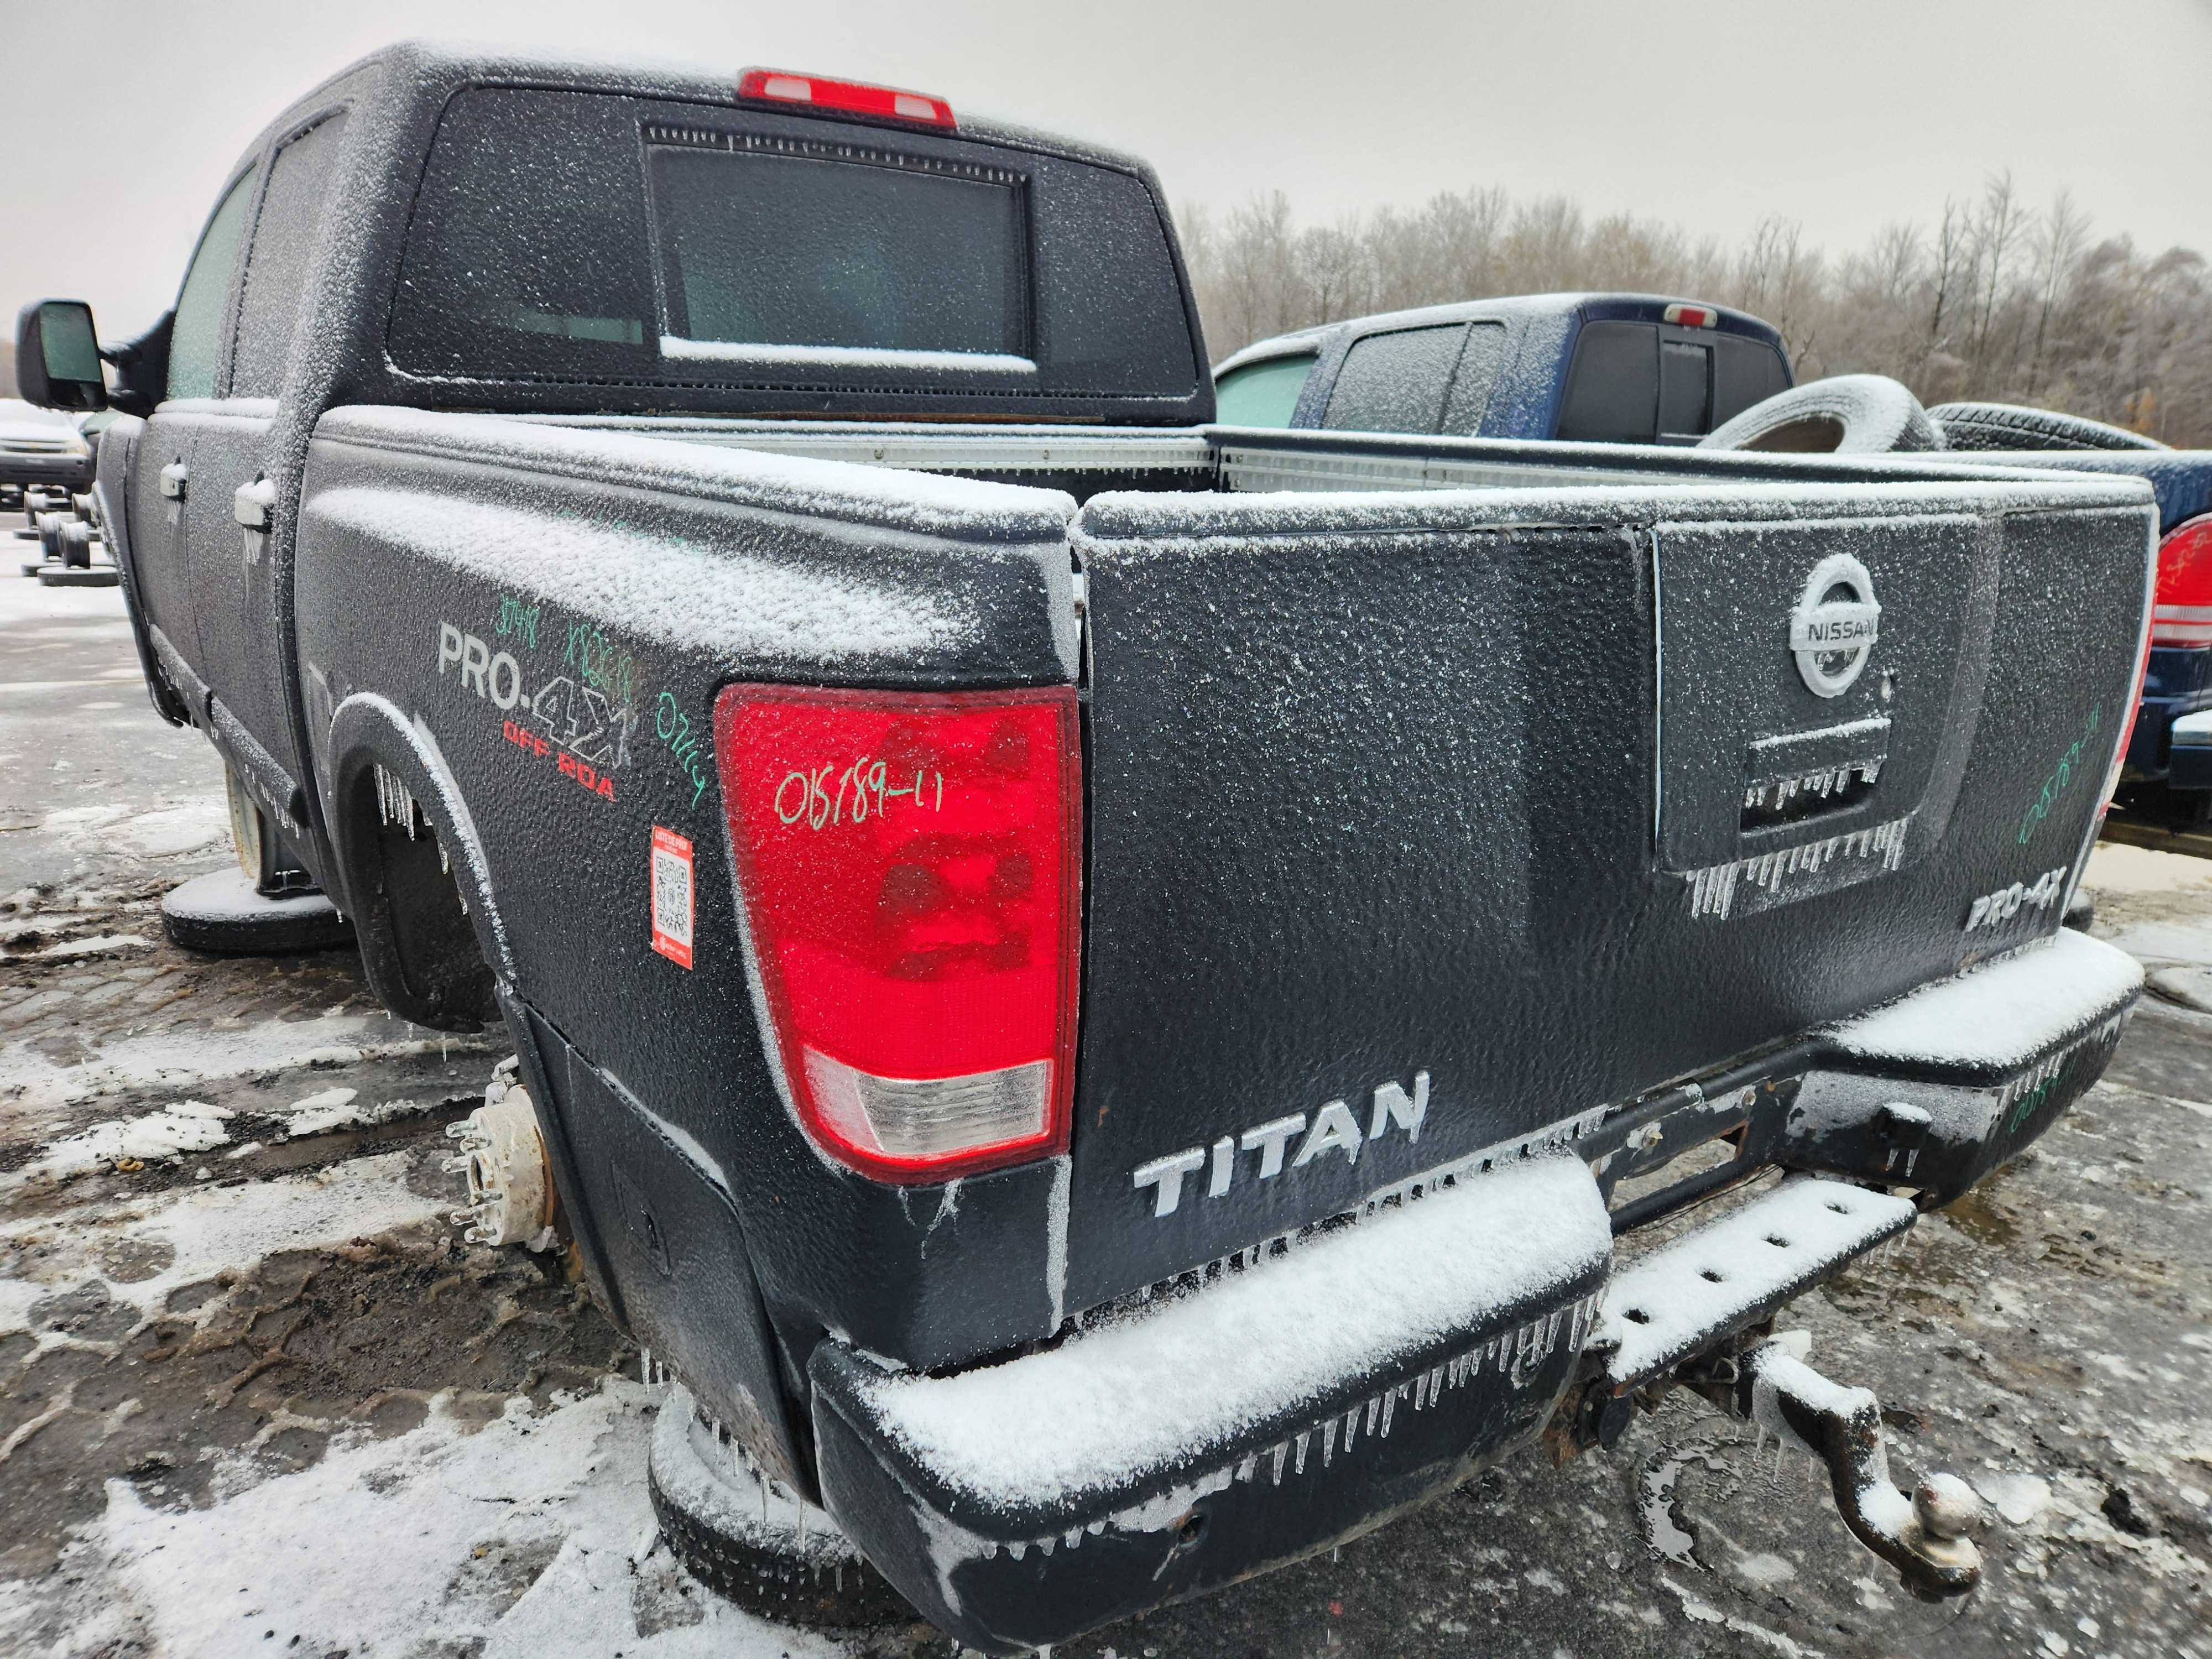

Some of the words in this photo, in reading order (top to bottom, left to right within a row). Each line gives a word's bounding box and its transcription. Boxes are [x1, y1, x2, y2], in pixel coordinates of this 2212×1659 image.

[1809, 619, 1874, 641] NISSAN
[504, 720, 549, 760] OFF
[1965, 865, 2067, 932] PRO-4X
[1134, 1070, 1431, 1217] TITAN
